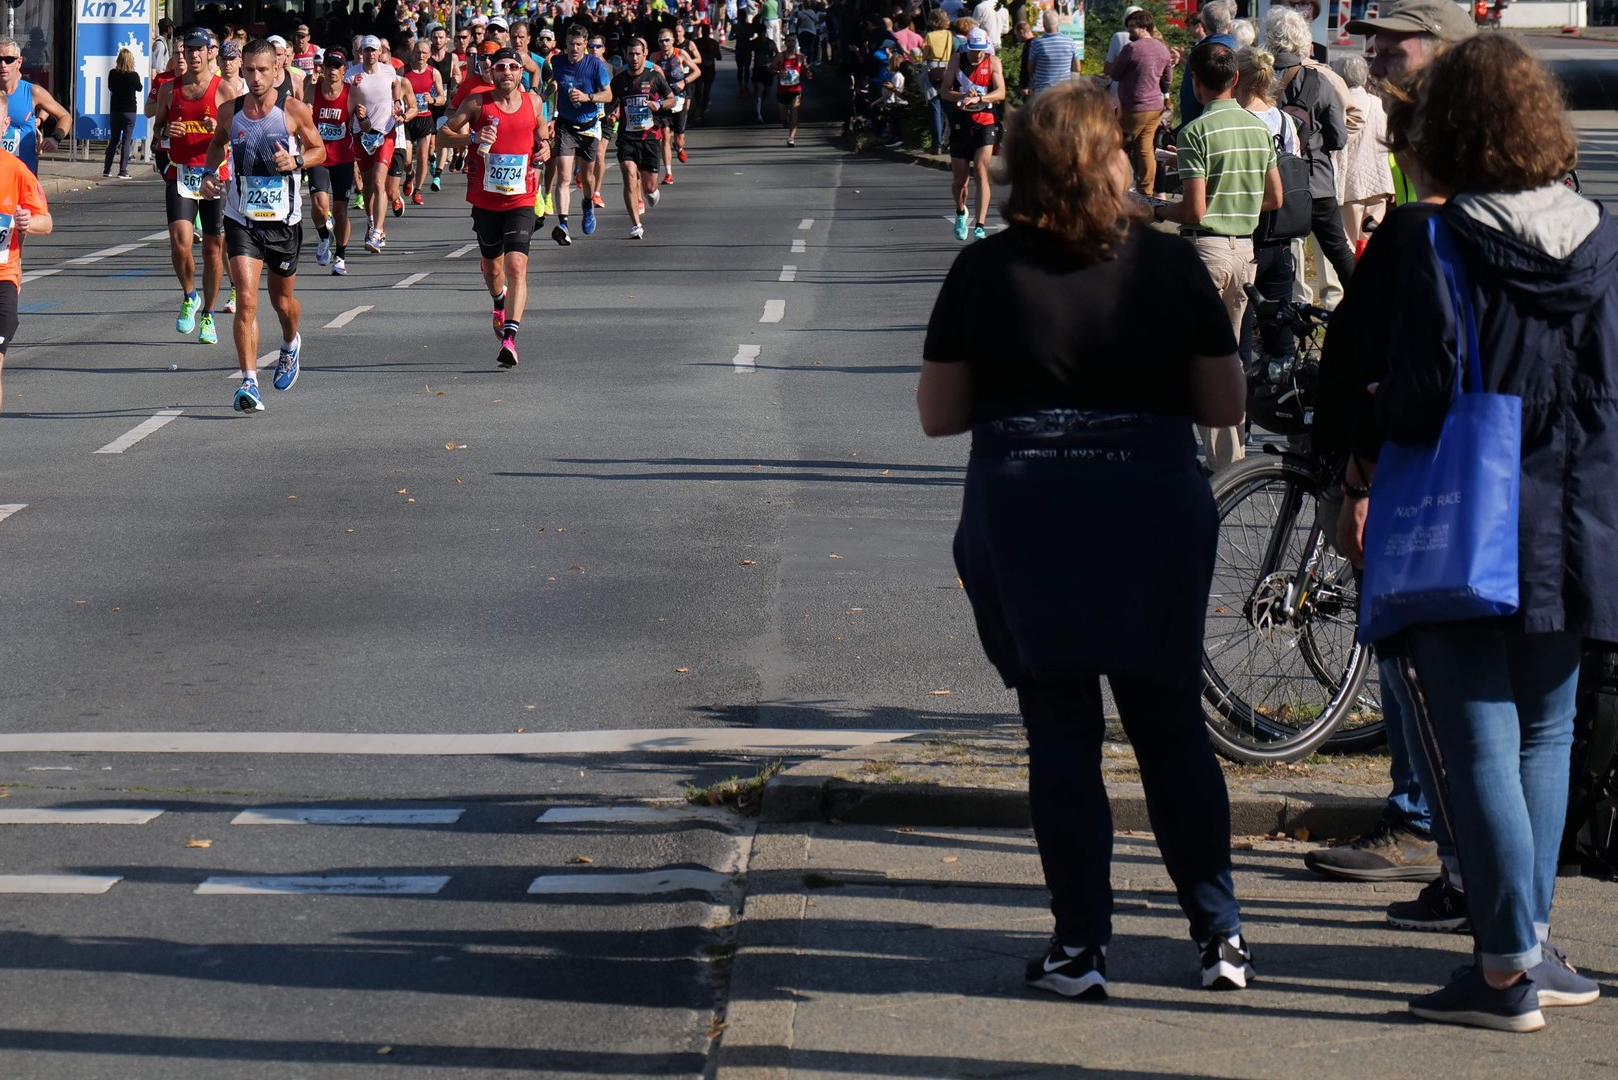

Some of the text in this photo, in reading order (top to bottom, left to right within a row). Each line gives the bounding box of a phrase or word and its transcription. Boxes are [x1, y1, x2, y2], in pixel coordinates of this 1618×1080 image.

[1, 139, 14, 153] 36
[183, 175, 202, 187] 561
[489, 167, 522, 181] 26734
[247, 190, 282, 204] 22354
[1437, 490, 1462, 506] RACE
